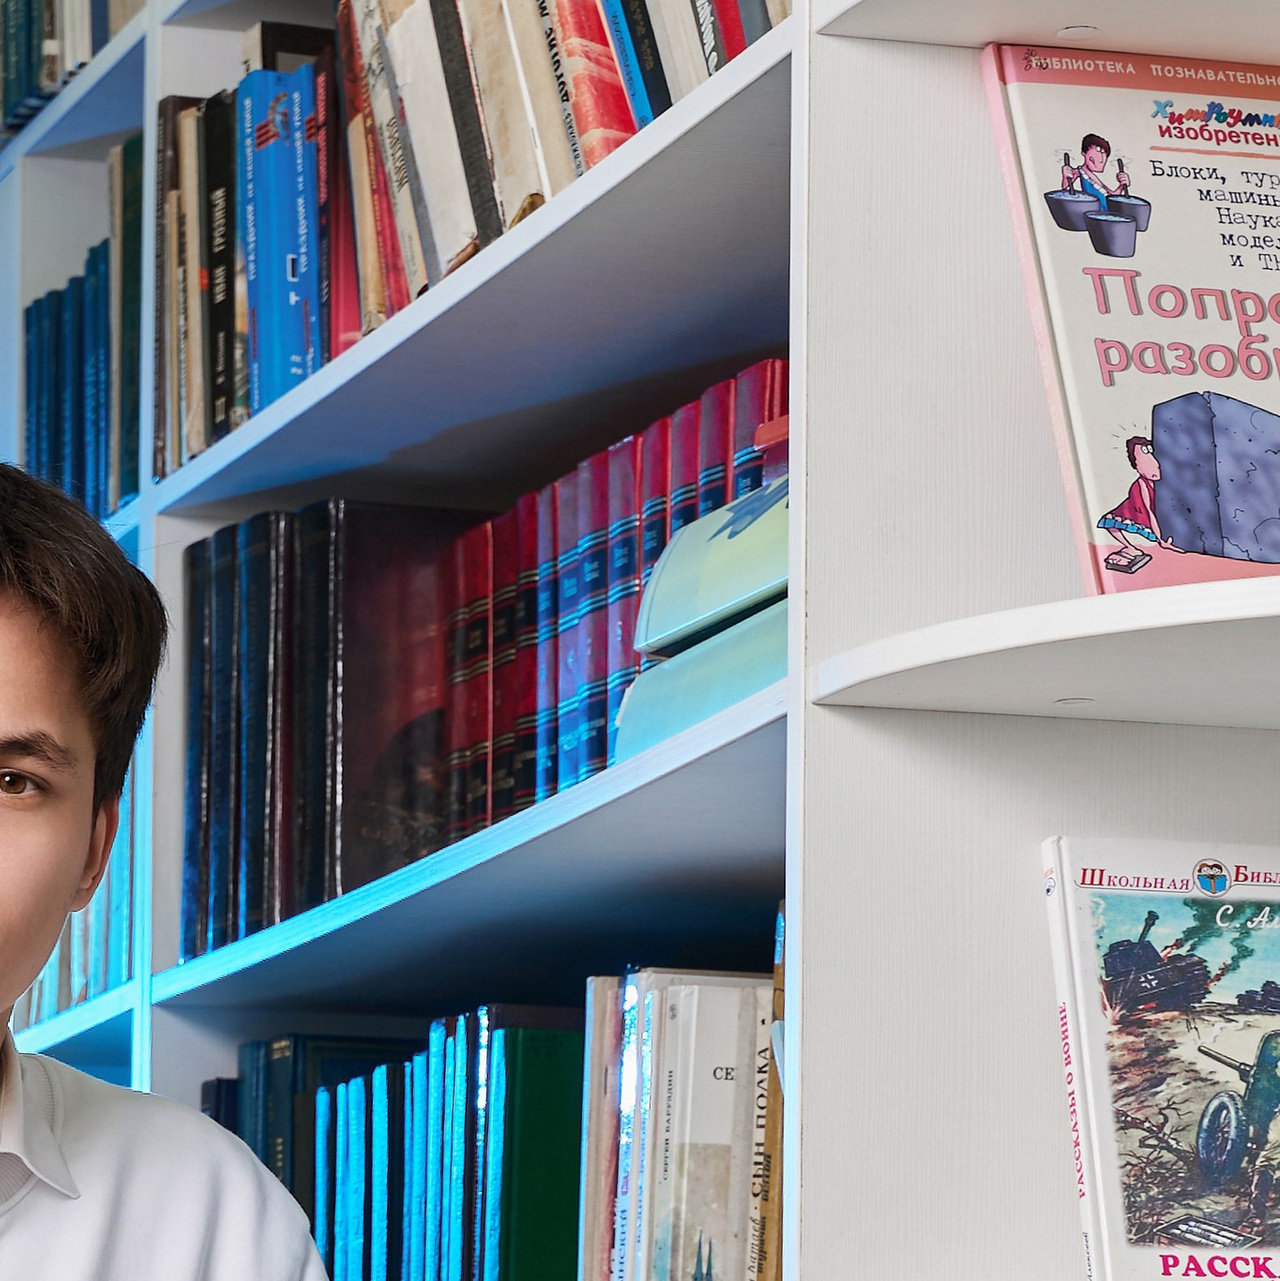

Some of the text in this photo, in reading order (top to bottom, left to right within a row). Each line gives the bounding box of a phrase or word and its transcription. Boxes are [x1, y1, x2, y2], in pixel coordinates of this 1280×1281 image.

[1150, 160, 1227, 184] Блоки,
[208, 187, 227, 303] ИВАН ГРОЗНЫЙ
[1230, 255, 1244, 267] и
[1094, 334, 1280, 387] разоб
[1080, 867, 1190, 891] ШКОЛЬНАЯ
[751, 1045, 770, 1129] ПОЛКА
[750, 1141, 765, 1199] СЫН
[1067, 1095, 1086, 1199] РАССКАЗЫ
